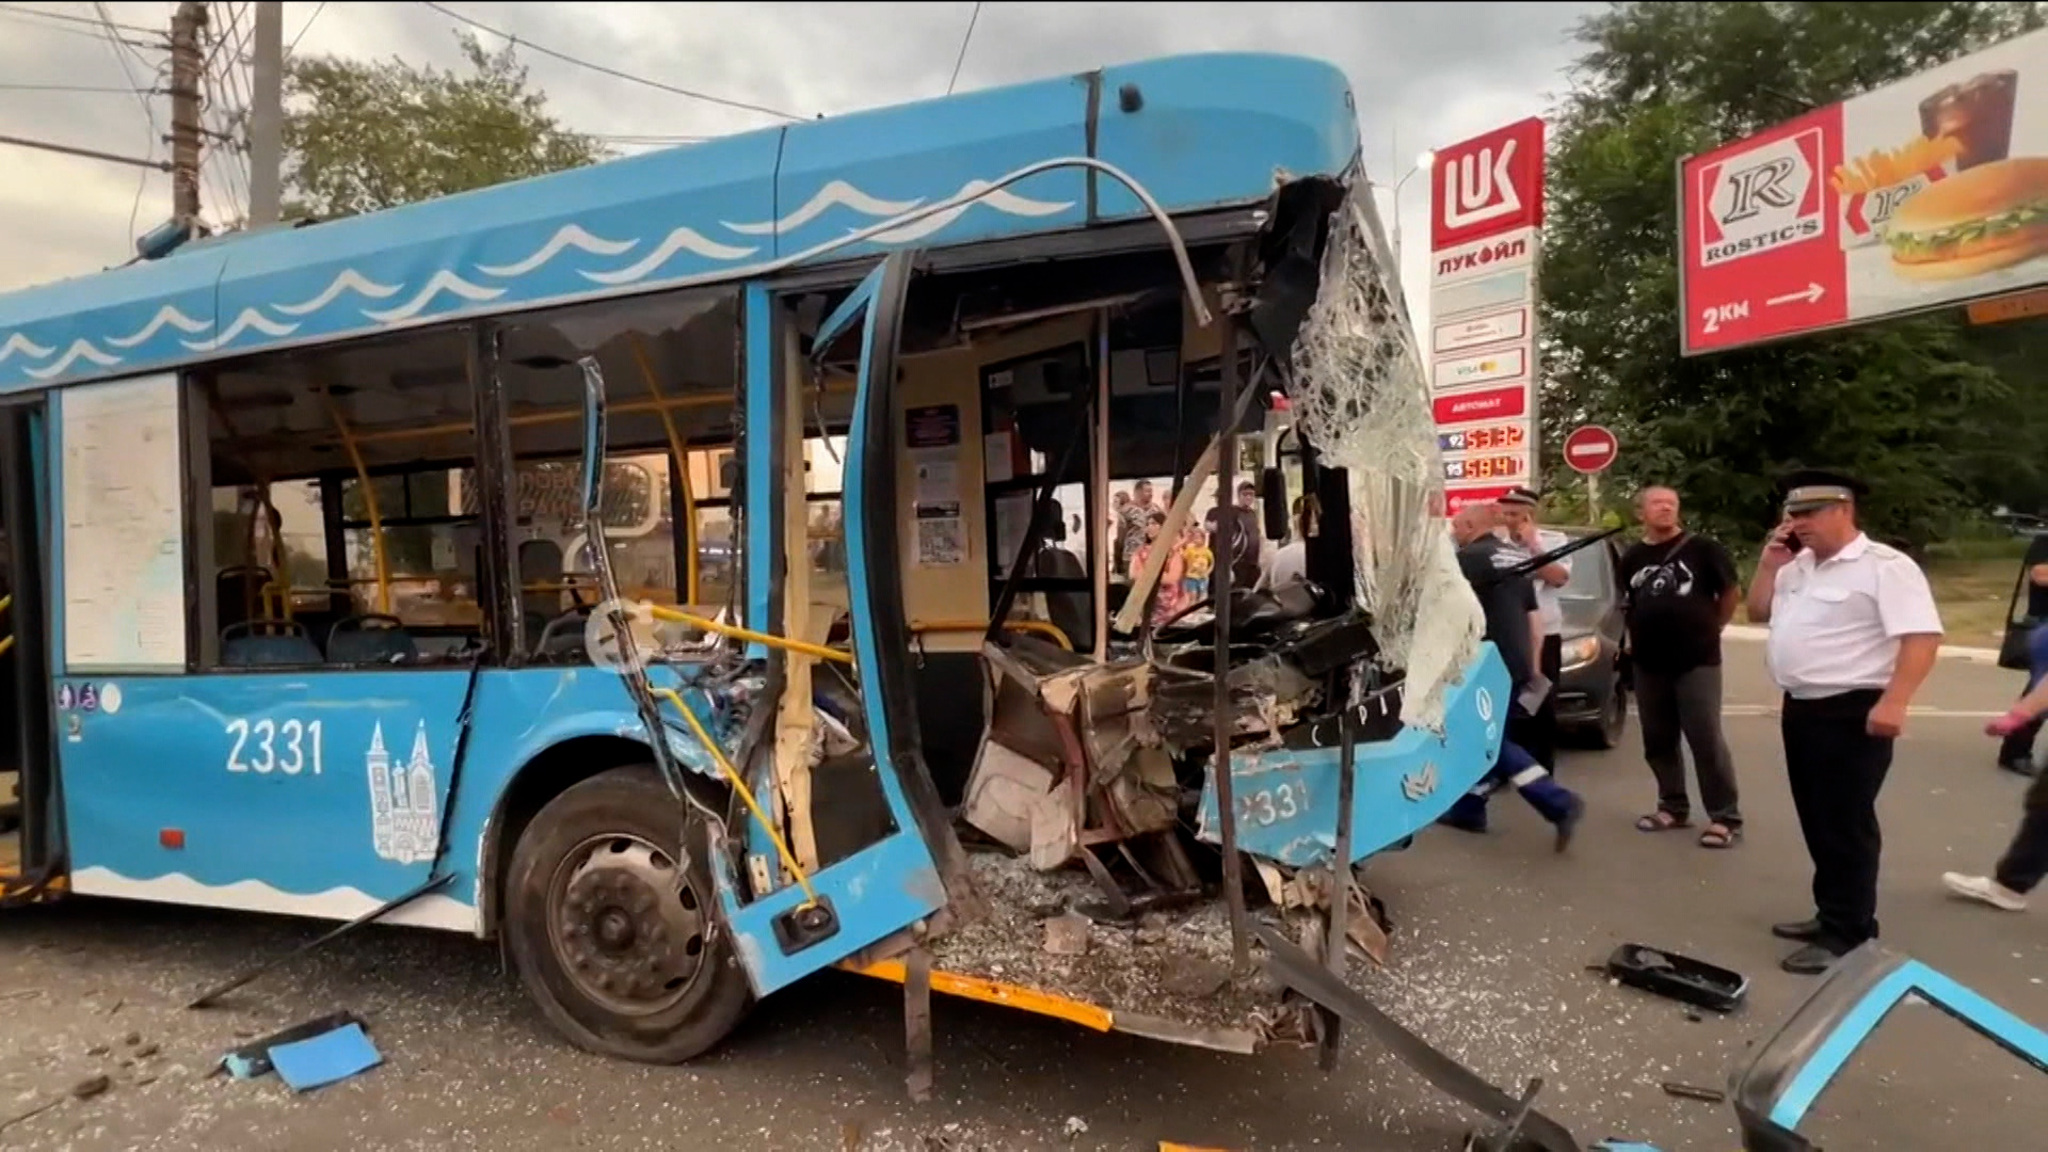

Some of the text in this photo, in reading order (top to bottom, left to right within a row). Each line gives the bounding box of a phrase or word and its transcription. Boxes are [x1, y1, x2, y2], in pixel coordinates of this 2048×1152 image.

[1437, 238, 1526, 276] ЛУКОЙЛ
[1705, 218, 1819, 263] ROSTIC'S
[1449, 433, 1465, 448] 92
[1446, 463, 1464, 477] 95
[225, 717, 322, 775] 2331
